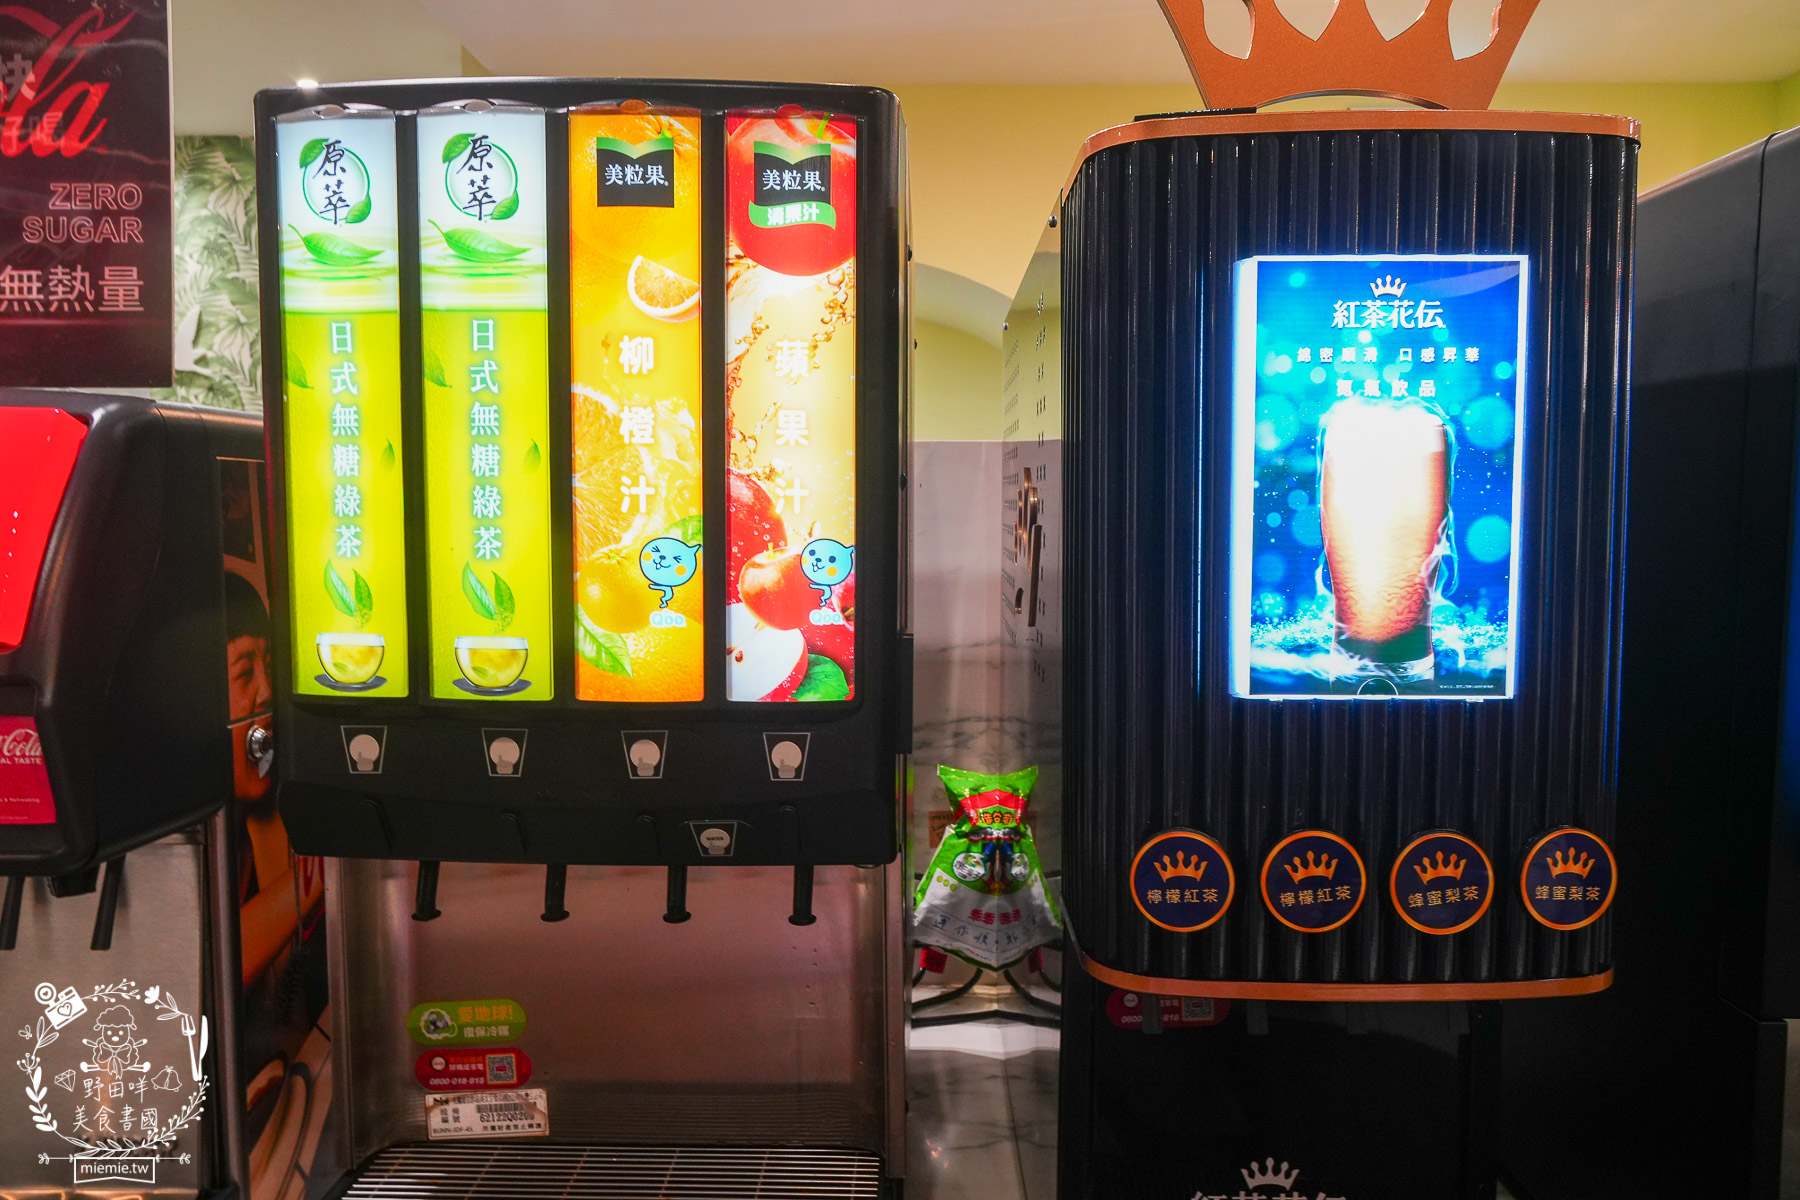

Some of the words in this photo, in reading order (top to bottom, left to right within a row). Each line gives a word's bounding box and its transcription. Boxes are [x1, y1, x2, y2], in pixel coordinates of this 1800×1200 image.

[313, 140, 350, 225] 原萃
[456, 135, 497, 221] 原萃
[605, 164, 665, 187] 美粒果
[762, 169, 822, 191] 美粒果
[49, 183, 143, 210] ZERO
[22, 216, 144, 243] SUGAR
[0, 264, 144, 312] 無熱量
[1331, 300, 1445, 329] 紅茶花伝
[619, 335, 656, 514] 柳橙汁
[774, 339, 810, 515] 蘋果汁
[330, 321, 362, 558] 日式無糖綠茶
[469, 319, 503, 560] 日式無糖綠茶
[651, 611, 685, 626] Qoo
[810, 611, 843, 625] Qoo
[14, 756, 42, 765] TASTE
[1147, 888, 1218, 904] 檸檬紅茶
[1280, 886, 1352, 908] 檸檬紅茶
[1409, 886, 1479, 908] 蜂蜜梨茶
[1535, 885, 1601, 901] 蜂蜜梨茶
